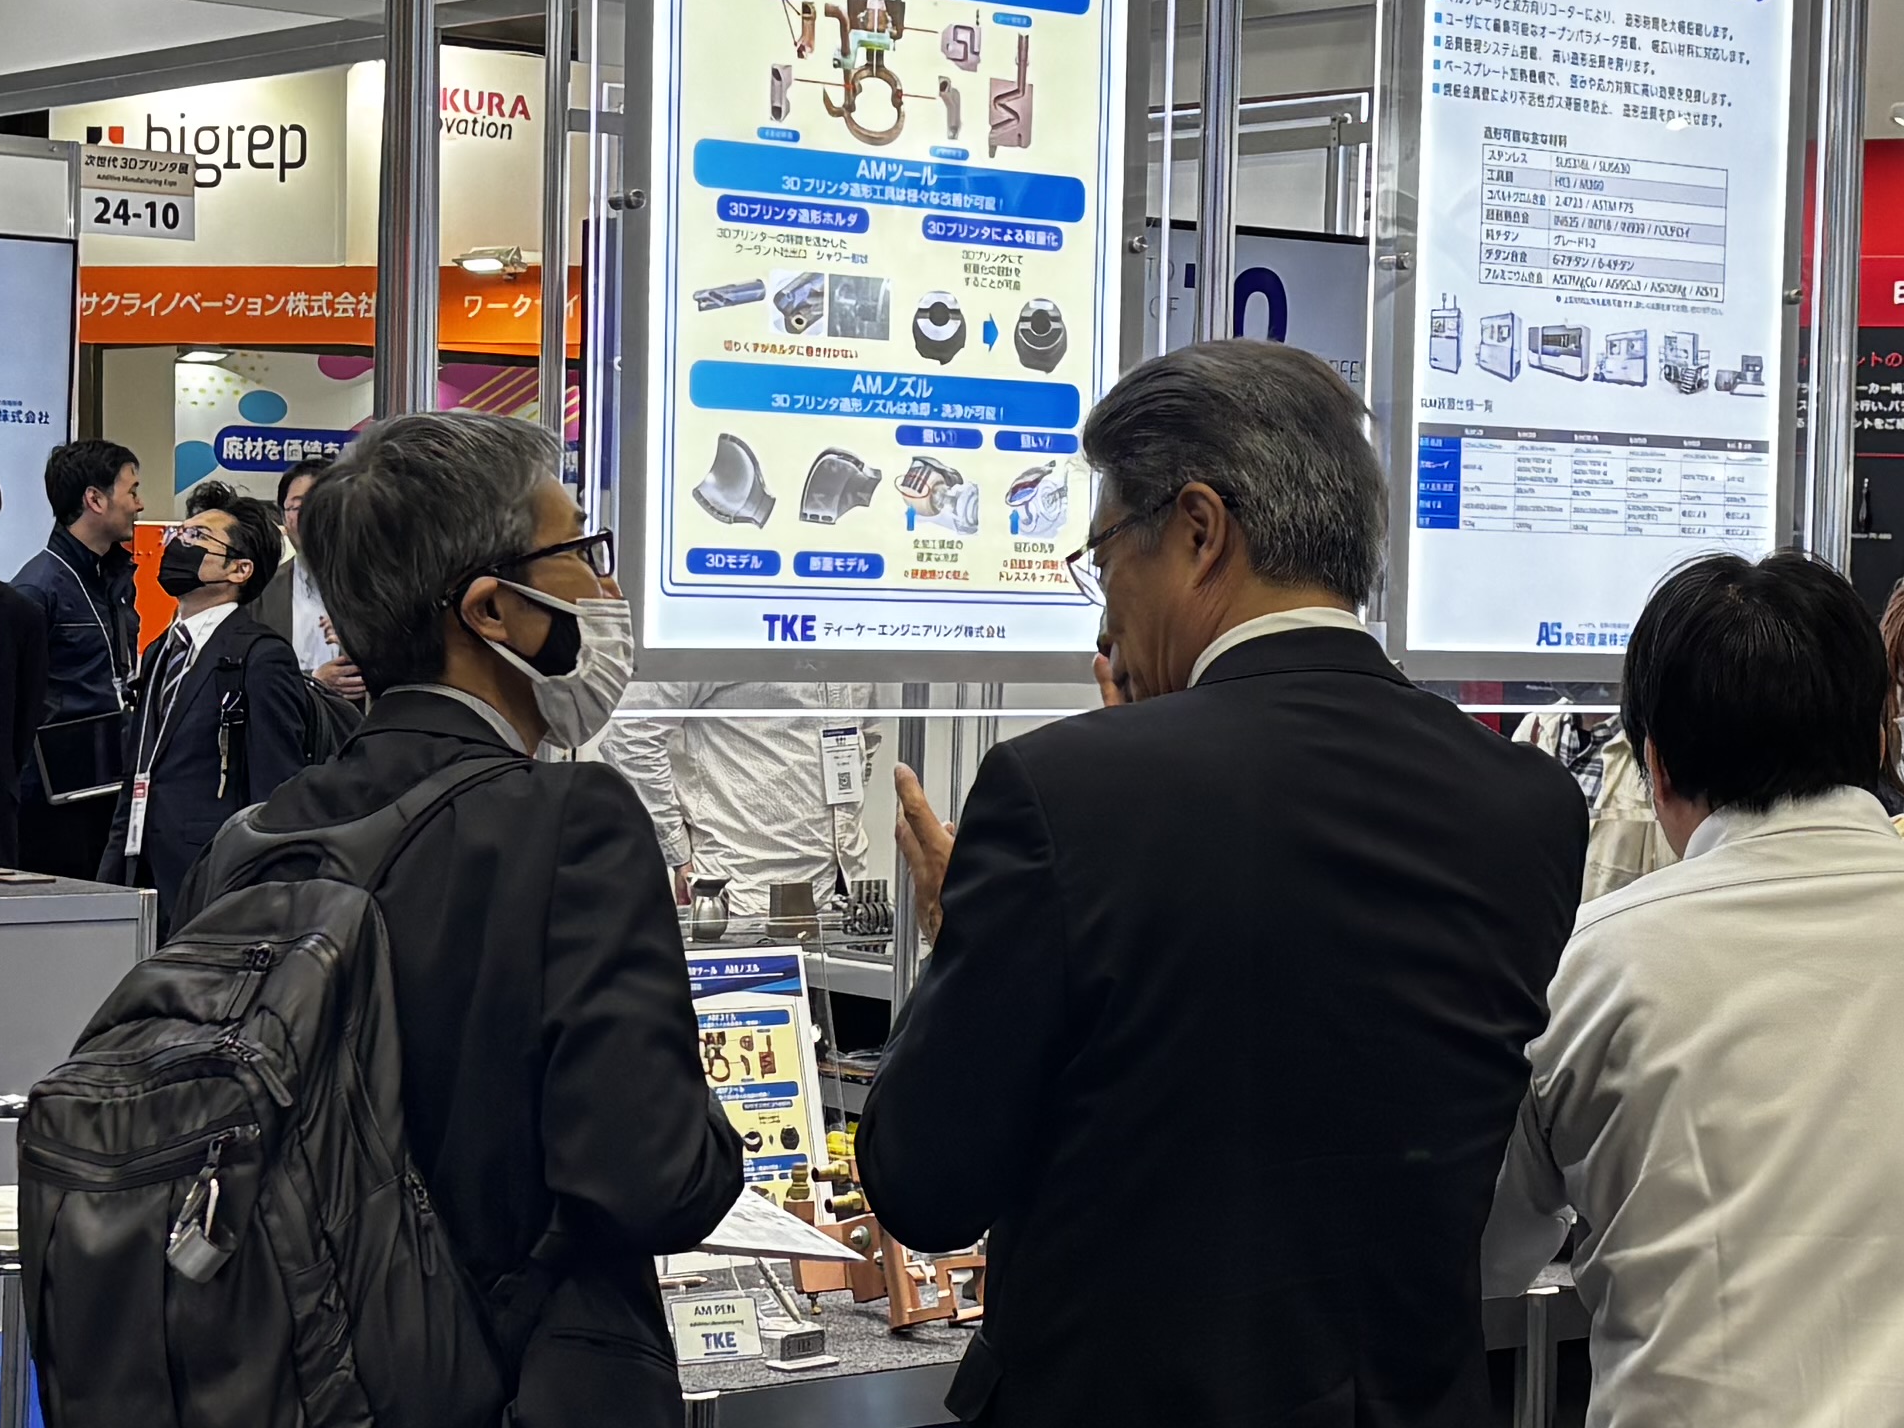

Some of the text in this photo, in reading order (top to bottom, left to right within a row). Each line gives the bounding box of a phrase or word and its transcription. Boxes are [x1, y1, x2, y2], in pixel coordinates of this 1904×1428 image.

[856, 159, 938, 187] AMツール
[94, 196, 179, 230] 24-10
[80, 291, 376, 318] サクライノベーション株式会社
[852, 374, 933, 398] AMノズル
[705, 553, 763, 571] 3Dモデル
[763, 613, 816, 642] TKE
[701, 1331, 737, 1350] TKE
